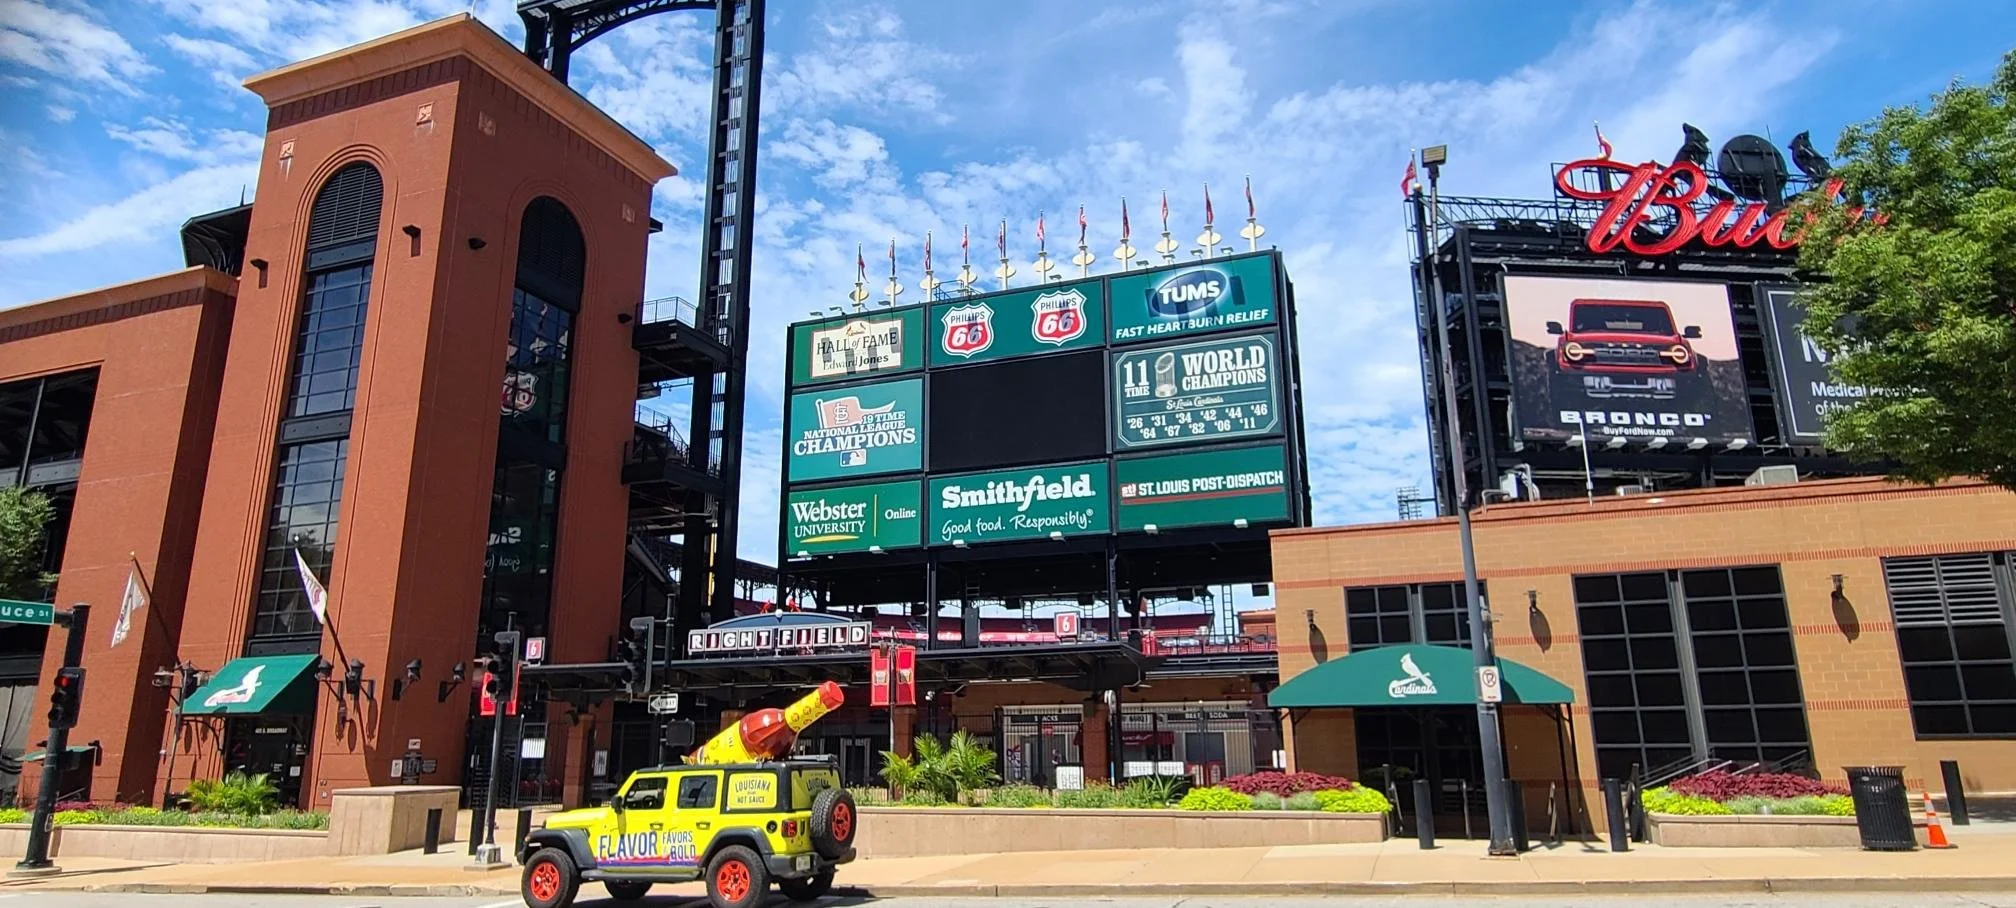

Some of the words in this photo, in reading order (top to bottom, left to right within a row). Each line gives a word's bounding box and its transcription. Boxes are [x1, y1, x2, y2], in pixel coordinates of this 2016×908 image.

[1159, 281, 1220, 304] TUMS
[1040, 297, 1077, 311] PHILLIPS
[950, 310, 985, 324] PHILLIPS
[1041, 312, 1075, 334] 66
[1115, 326, 1144, 339] FAST
[1147, 315, 1223, 335] HEARTBURN
[1226, 309, 1269, 324] RELIEF
[817, 338, 850, 355] HALL
[852, 337, 861, 350] of
[862, 331, 898, 349] FAME
[951, 325, 982, 347] 66
[823, 356, 857, 370] Edward
[859, 354, 889, 367] Jones
[1181, 345, 1266, 376] WORLD
[1124, 359, 1149, 387] 11
[1182, 367, 1266, 391] CHAMPIONS
[1124, 386, 1150, 398] TIME
[1811, 381, 1866, 397] Medical
[1816, 400, 1829, 415] of
[862, 415, 873, 425] 19
[875, 411, 906, 422] TIME
[804, 425, 859, 440] NATIONAL
[860, 420, 906, 434] LEAGUE
[1603, 426, 1674, 436] BuyFordNow.com
[794, 428, 916, 456] CHAMPIONS
[1139, 481, 1156, 496] ST.
[1156, 479, 1190, 494] LOUIS
[1192, 470, 1284, 492] POST-DISPATCH
[791, 499, 867, 523] Webster
[885, 508, 916, 520] Online
[794, 520, 866, 538] UNIVERSITY
[942, 518, 972, 541] Good
[976, 516, 1006, 536] food.
[1063, 616, 1070, 631] 6
[691, 631, 769, 649] RIGHT
[782, 626, 865, 642] FIELD
[530, 643, 537, 656] 6
[1388, 681, 1438, 698] Cardinals
[735, 779, 771, 793] LOUISIANA
[599, 830, 658, 859] FLAVOR
[662, 830, 693, 845] FAVORS
[670, 844, 696, 860] BOLD
